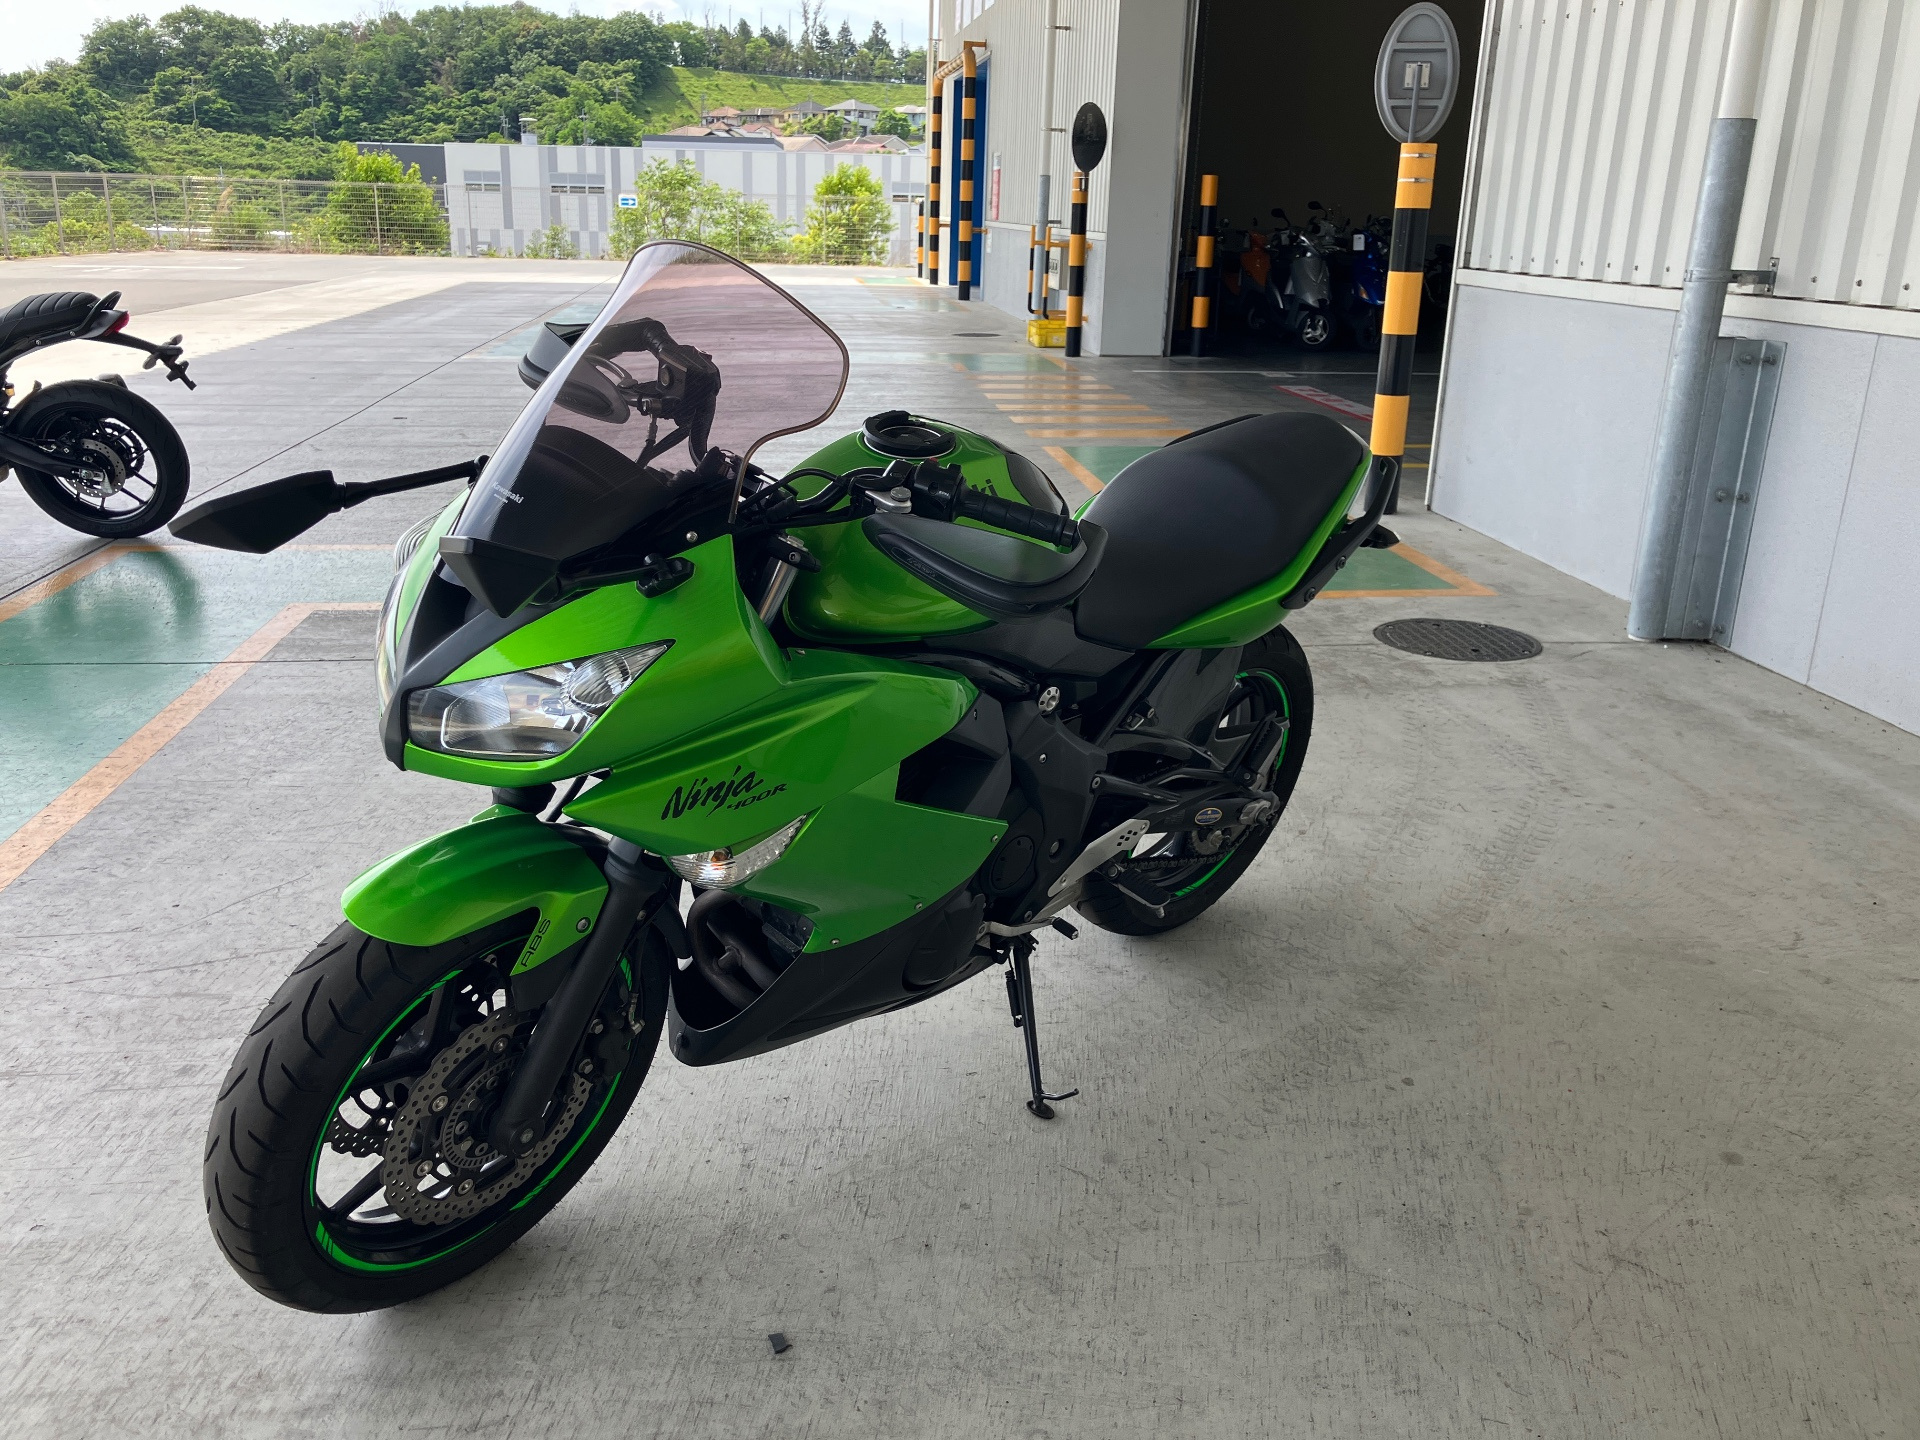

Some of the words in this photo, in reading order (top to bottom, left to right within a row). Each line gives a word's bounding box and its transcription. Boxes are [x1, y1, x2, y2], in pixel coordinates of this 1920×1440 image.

[491, 481, 525, 504] Kawasaki
[661, 765, 765, 821] Ninja
[727, 783, 788, 811] 400R
[521, 918, 551, 967] ABS
